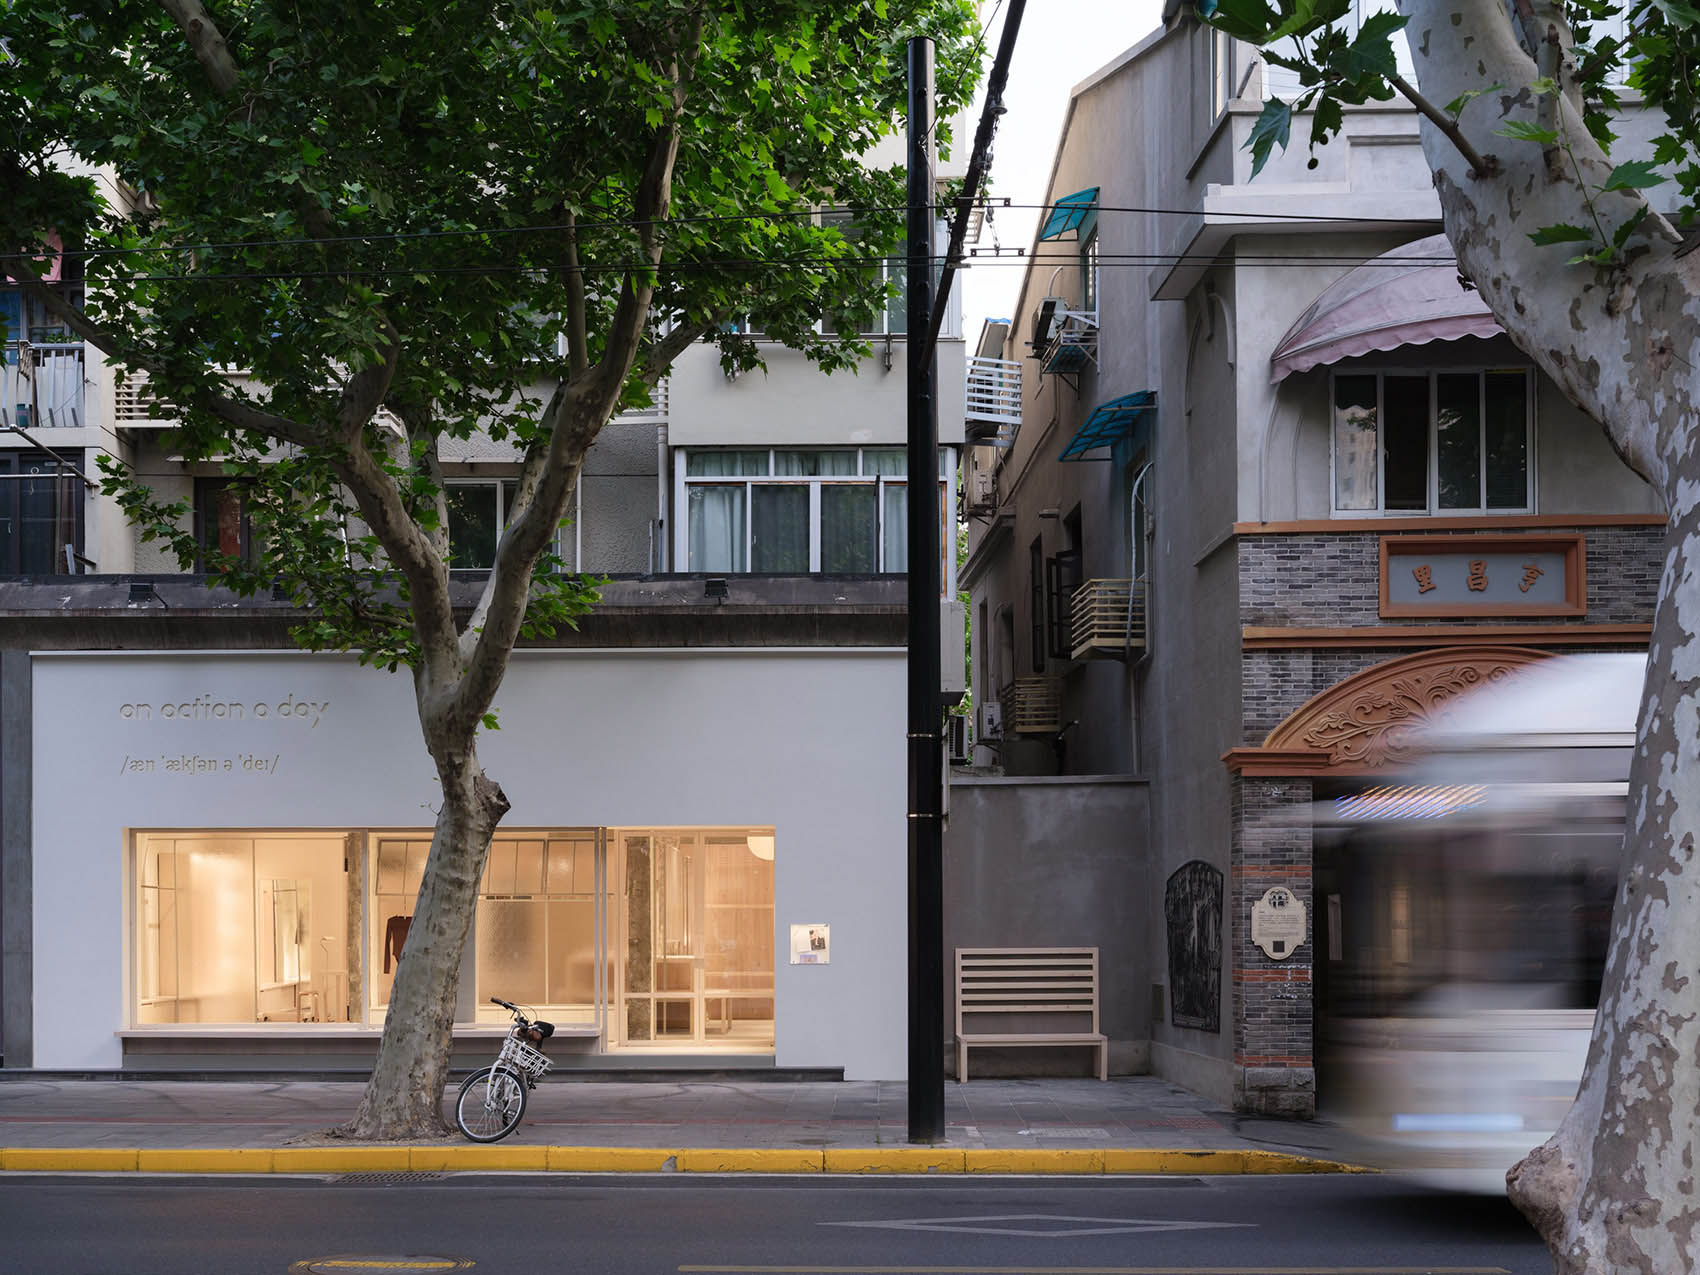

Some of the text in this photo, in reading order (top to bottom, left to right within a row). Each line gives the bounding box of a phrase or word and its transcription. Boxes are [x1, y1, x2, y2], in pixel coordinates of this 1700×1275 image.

[119, 703, 152, 719] an
[160, 694, 245, 719] action
[277, 693, 329, 729] day
